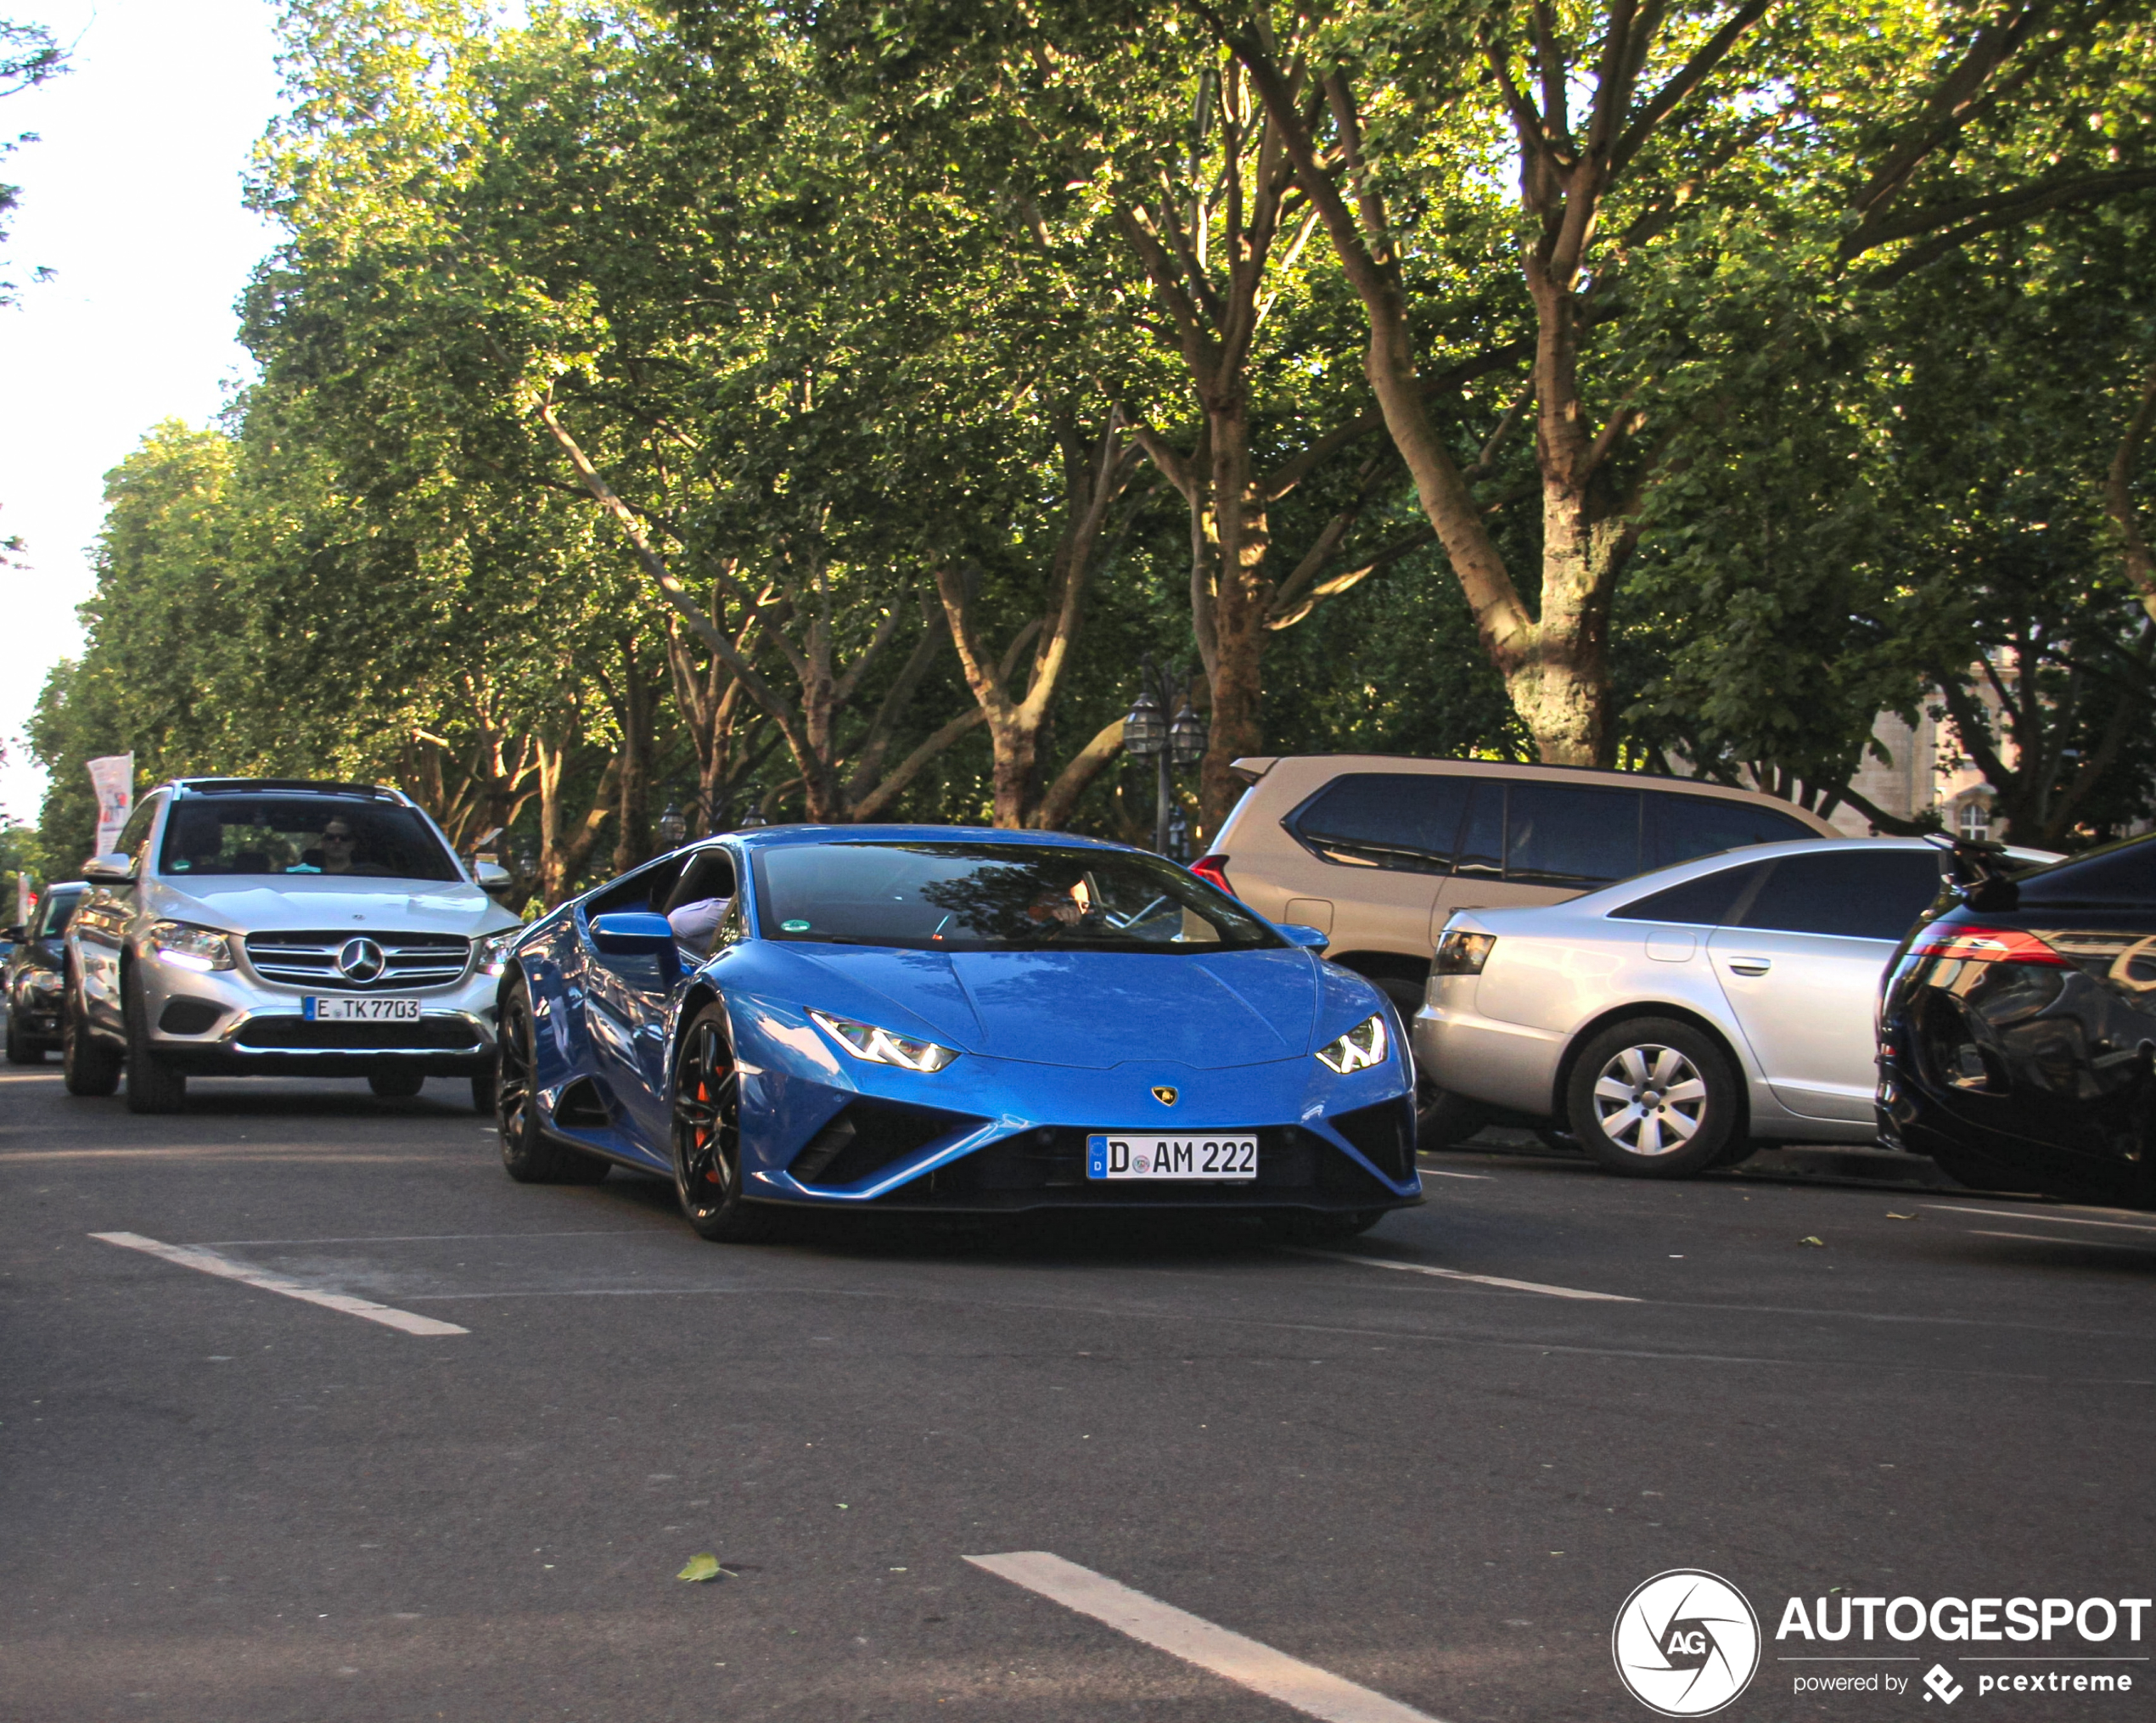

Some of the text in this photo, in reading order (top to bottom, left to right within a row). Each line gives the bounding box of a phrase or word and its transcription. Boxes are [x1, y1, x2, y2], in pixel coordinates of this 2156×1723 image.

[318, 1000, 329, 1017] E
[1094, 1161, 1102, 1171] D
[1109, 1142, 1255, 1173] D AM 222
